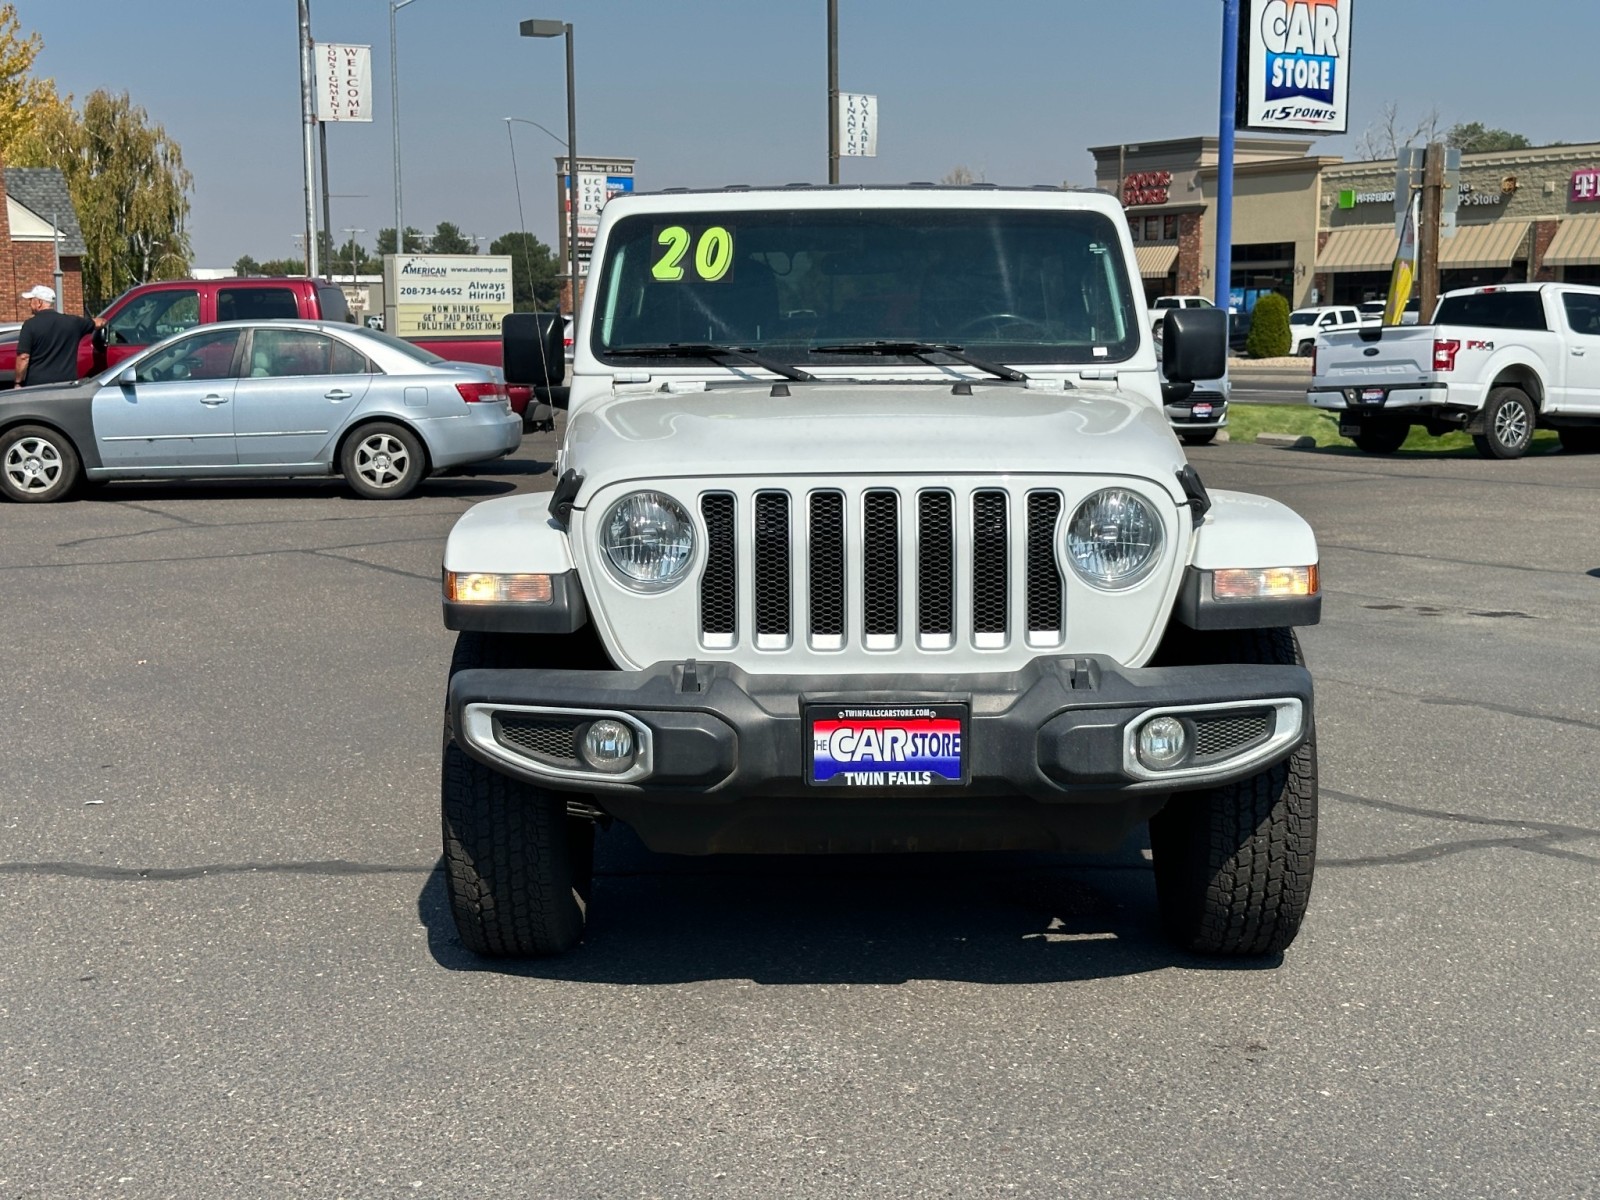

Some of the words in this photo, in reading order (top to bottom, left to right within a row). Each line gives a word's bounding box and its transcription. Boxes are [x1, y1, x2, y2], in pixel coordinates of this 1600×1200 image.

[1261, 0, 1339, 58] CAR
[327, 44, 340, 121] CONSIGNMENTS
[344, 48, 360, 118] WELCOME
[1271, 57, 1331, 90] STORE
[1261, 109, 1277, 120] AT
[1275, 106, 1294, 120] 5
[1293, 108, 1336, 120] POINTS
[847, 95, 857, 155] FINANCING
[860, 95, 869, 156] AVAILABLE
[583, 178, 592, 211] USED
[593, 178, 602, 211] CARS
[1472, 193, 1500, 206] Store
[651, 226, 733, 281] 20
[400, 287, 463, 296] 208-734-6452
[468, 281, 506, 291] Always
[468, 291, 506, 301] Hiring!
[423, 313, 436, 322] GET
[444, 313, 461, 321] PAID
[432, 304, 449, 313] NOW
[453, 304, 480, 313] HIRING
[1466, 340, 1494, 351] FX4
[844, 709, 930, 717] TWINFALLSCARSTORE.COM
[813, 739, 828, 751] THE
[829, 727, 908, 762] CAR
[911, 733, 960, 757] STORE
[844, 773, 885, 785] TWIN
[888, 772, 931, 785] FALLS
